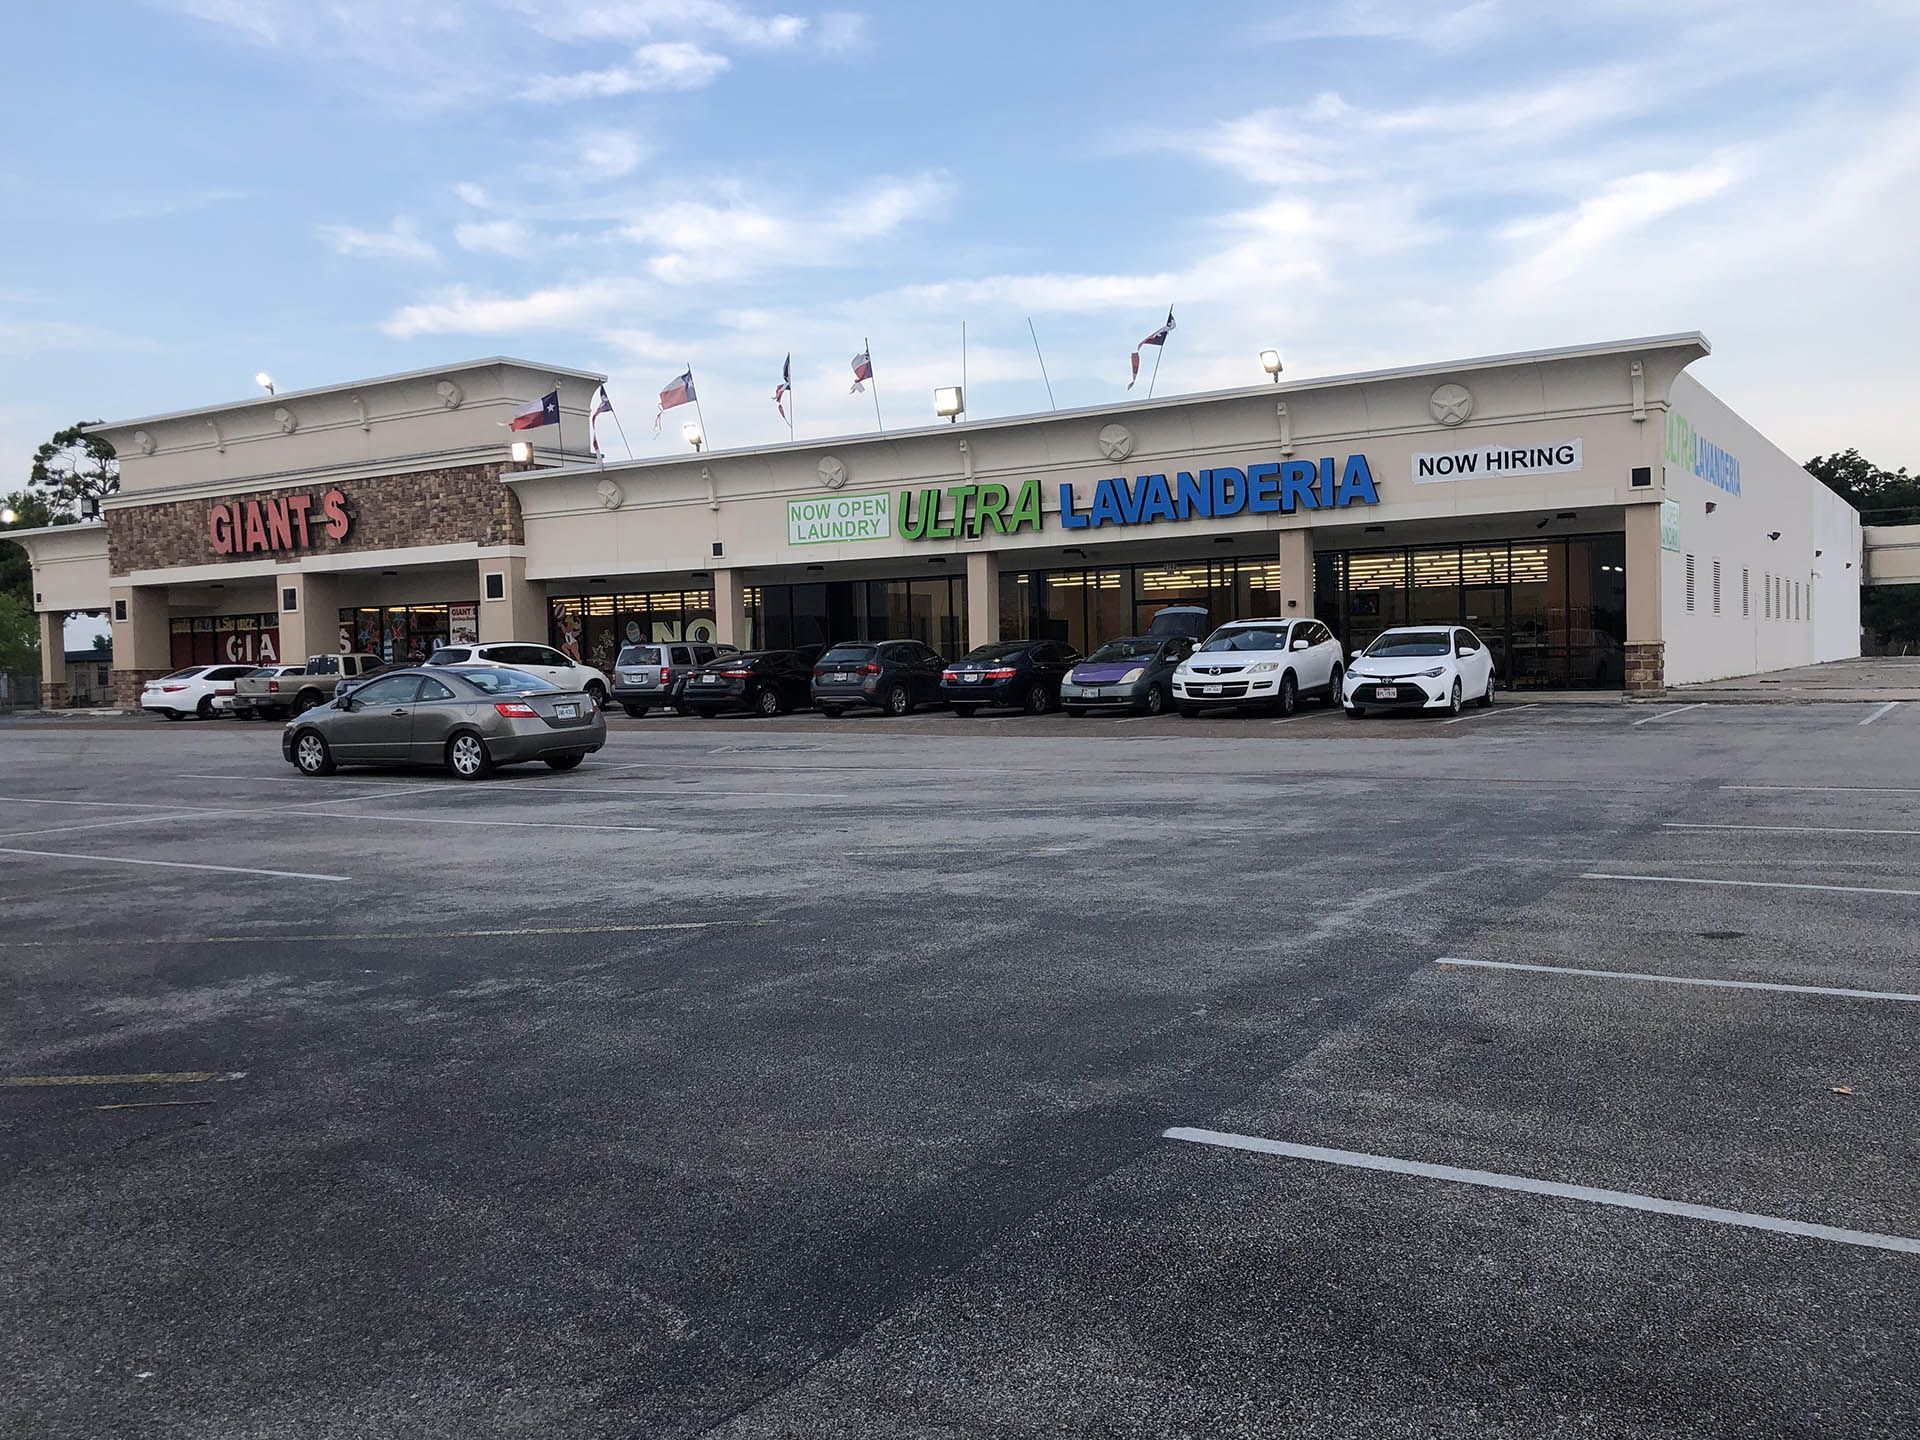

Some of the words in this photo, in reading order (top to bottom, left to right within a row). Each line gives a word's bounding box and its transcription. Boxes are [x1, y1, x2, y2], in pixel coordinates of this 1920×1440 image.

[1419, 453, 1478, 477] NOW
[1486, 445, 1575, 471] HIRING
[1694, 431, 1741, 498] LAVANDERIA
[791, 502, 833, 522] NOW
[837, 498, 887, 518] OPEN
[897, 479, 1042, 541] ULTRA
[1059, 453, 1380, 529] LAVANDERIA
[209, 494, 312, 555] GIANT
[797, 518, 881, 540] LAUNDRY
[226, 633, 277, 662] GIA
